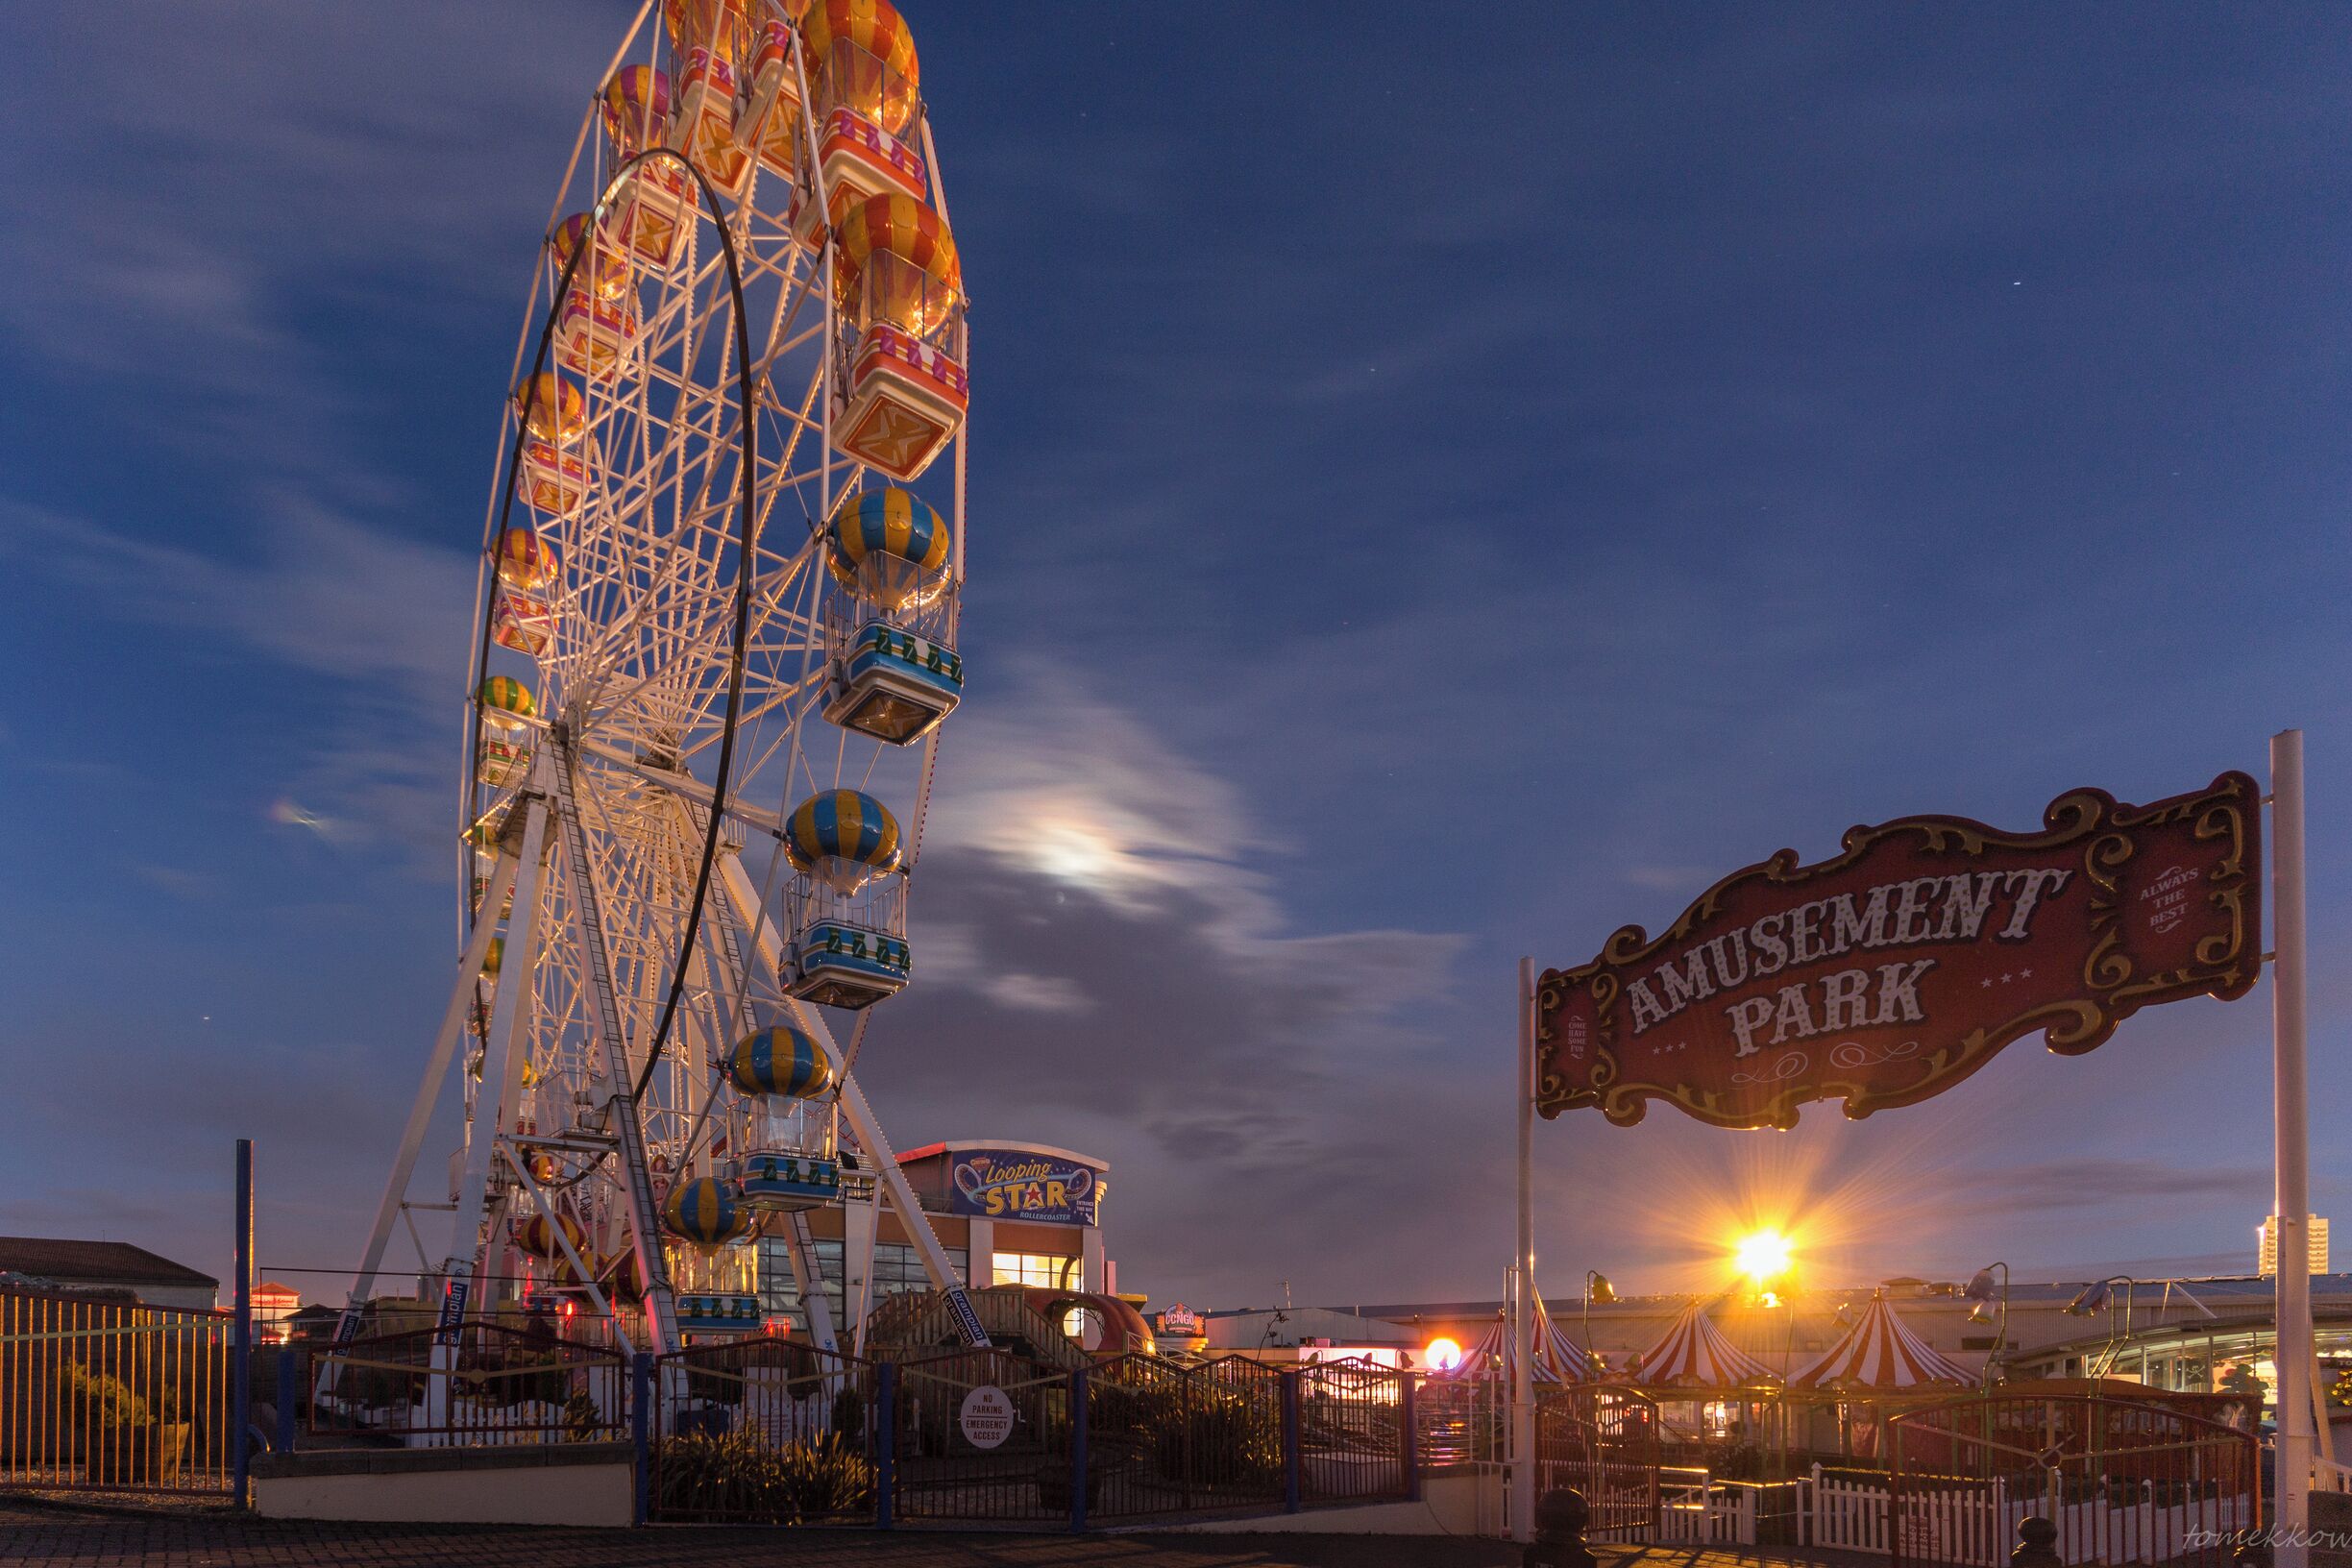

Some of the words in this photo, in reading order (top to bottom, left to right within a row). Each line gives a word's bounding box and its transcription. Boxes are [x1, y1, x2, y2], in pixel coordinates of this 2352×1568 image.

[2140, 868, 2199, 901] ALWAYS
[2152, 888, 2186, 909] THE
[2149, 902, 2189, 927] BEST
[1626, 868, 2074, 1034] AMUSEMENT
[1726, 958, 1938, 1059] PARK
[985, 1158, 1053, 1185] Looping
[985, 1181, 1069, 1215] STAR
[1019, 1212, 1071, 1221] ROLLERCOASTER
[944, 1297, 972, 1345] grampian
[953, 1291, 984, 1339] grampian
[1165, 1312, 1195, 1326] CONGO
[972, 1405, 1003, 1414] PARKING
[983, 1394, 992, 1403] NO
[966, 1419, 1008, 1430] EMERGENCY
[972, 1431, 1000, 1440] ACCESS
